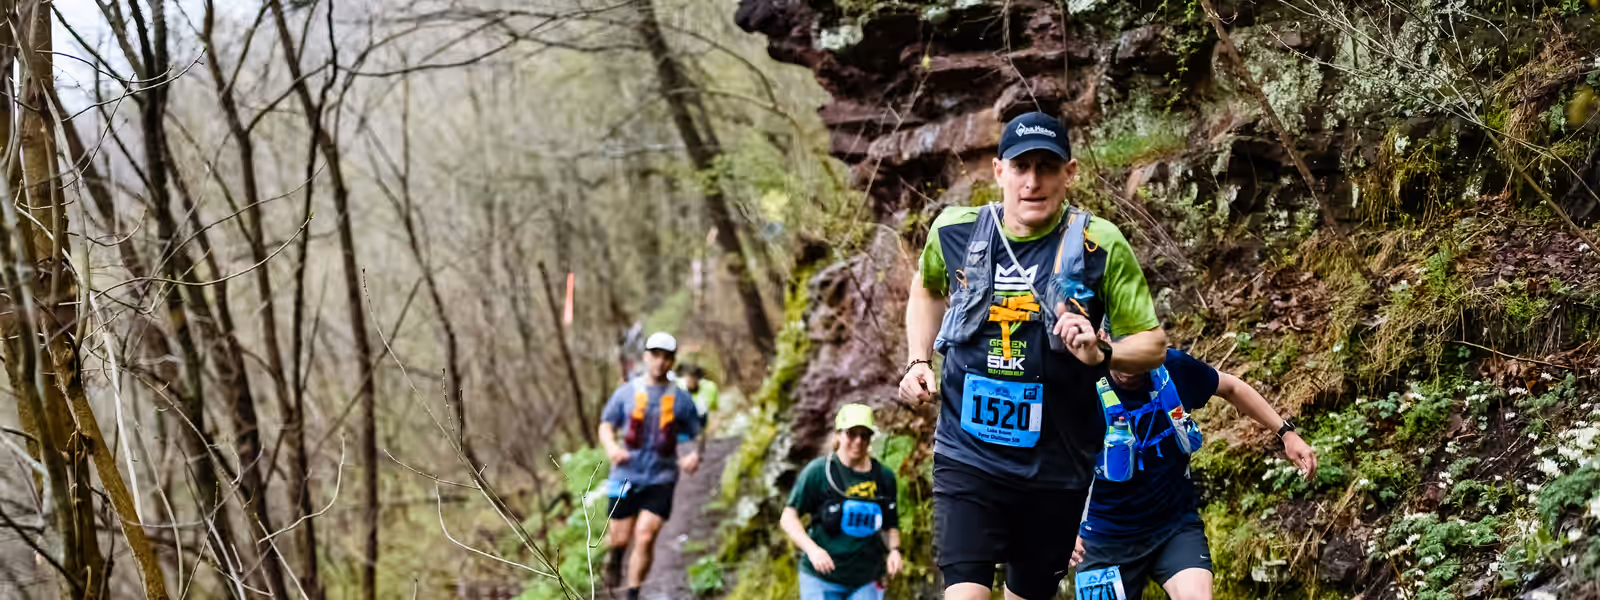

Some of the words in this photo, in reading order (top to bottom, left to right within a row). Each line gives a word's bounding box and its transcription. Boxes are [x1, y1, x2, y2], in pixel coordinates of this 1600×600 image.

[989, 339, 1027, 348] GREN
[988, 347, 1026, 357] JEEL
[987, 355, 1026, 370] 50K
[971, 395, 1031, 431] 1520
